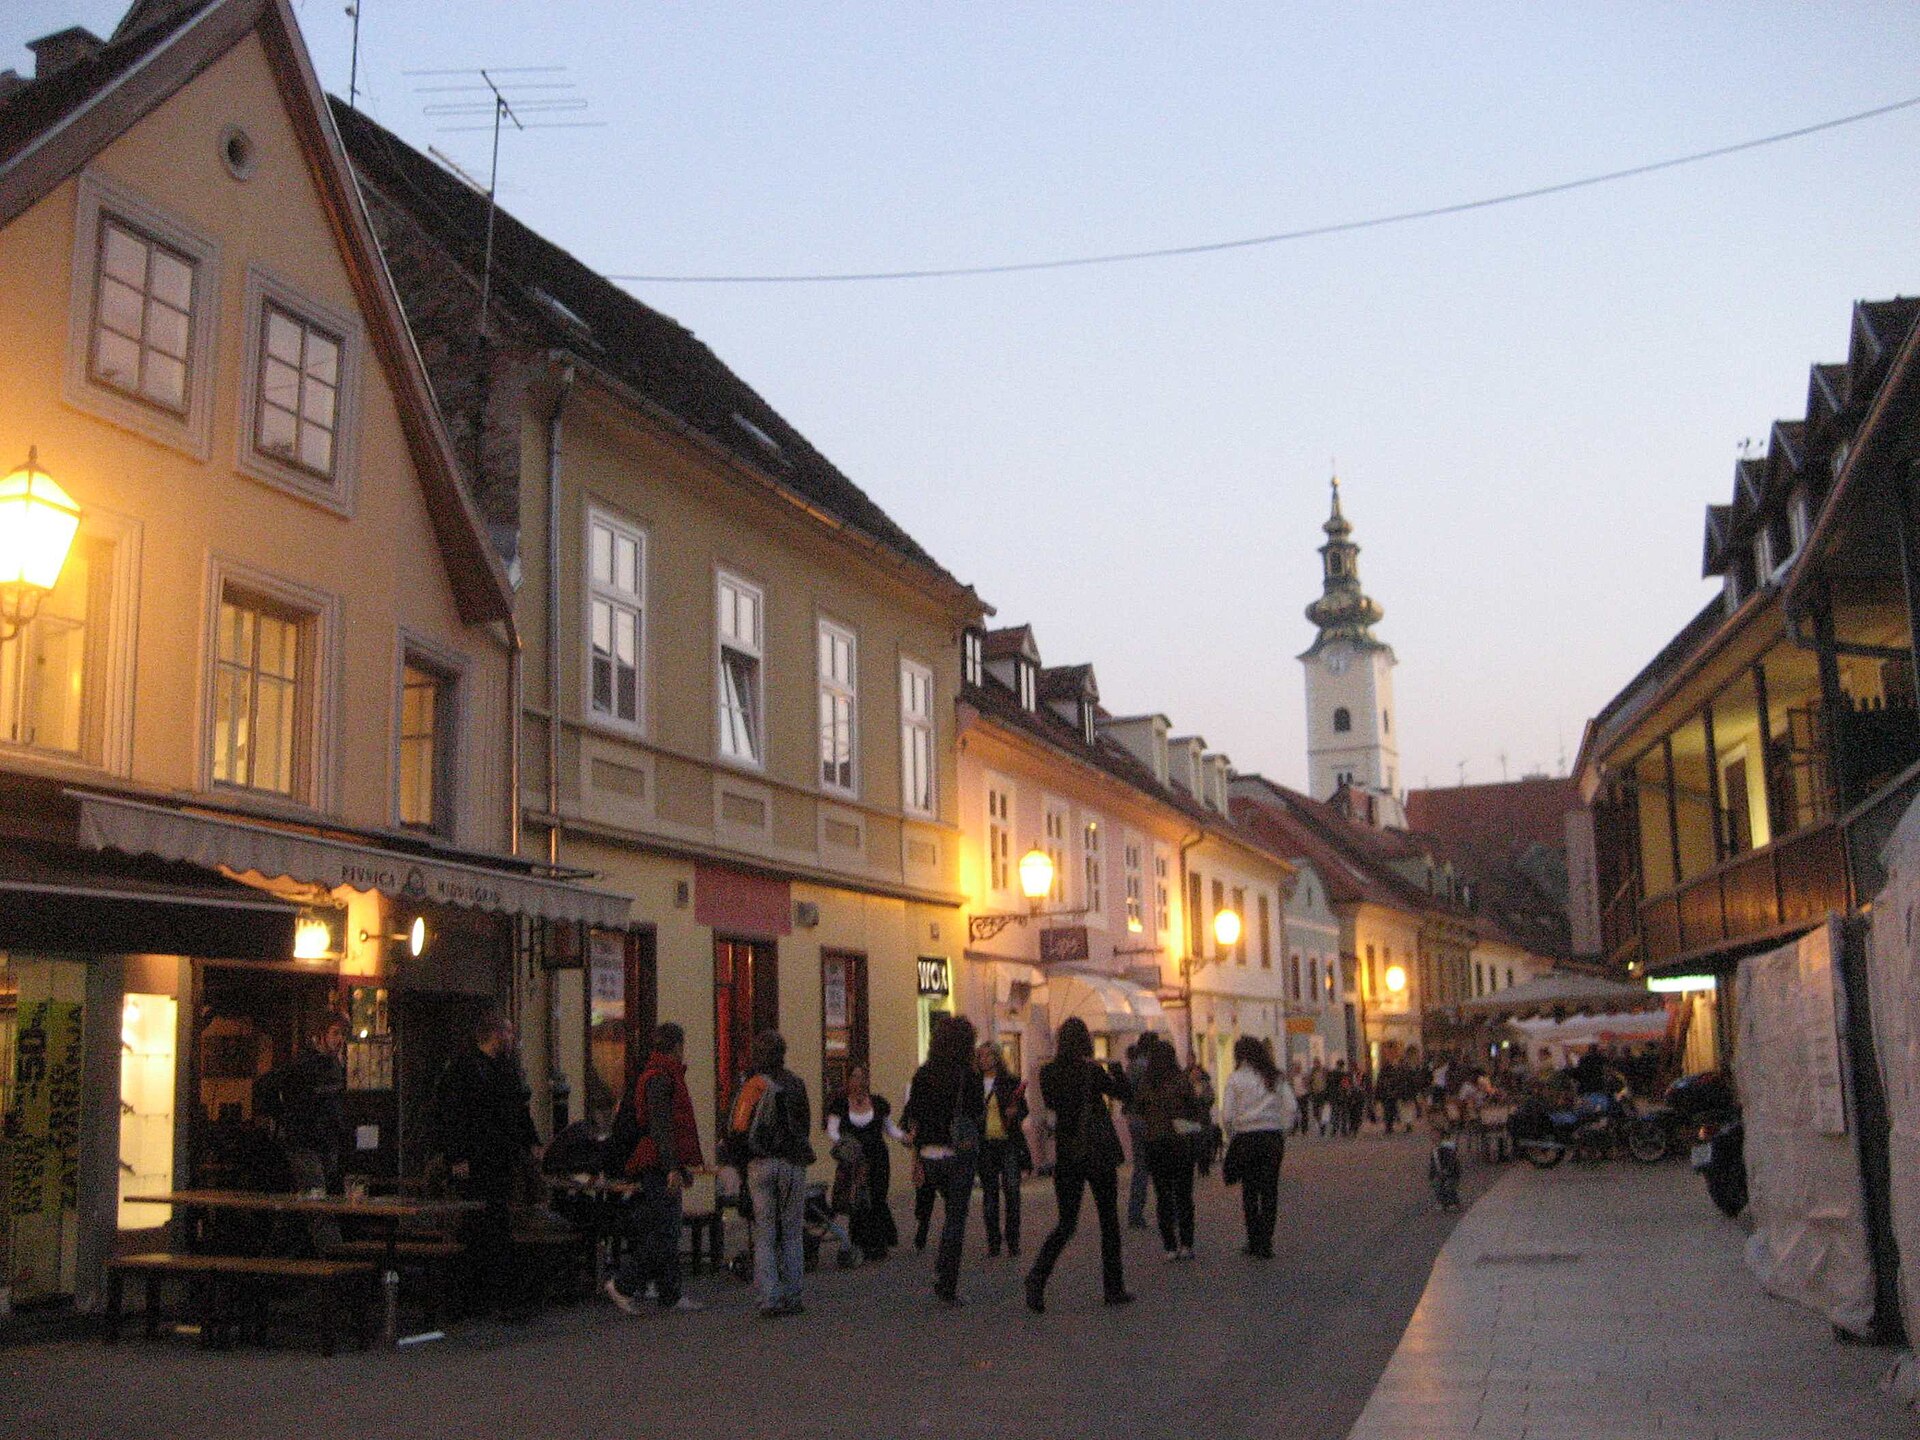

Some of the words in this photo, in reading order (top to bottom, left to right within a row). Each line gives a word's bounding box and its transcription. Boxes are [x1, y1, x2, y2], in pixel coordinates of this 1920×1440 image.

[341, 865, 395, 888] PIVNICA
[47, 1063, 66, 1151] ZBOG
[59, 1005, 83, 1211] ZATVARANJA
